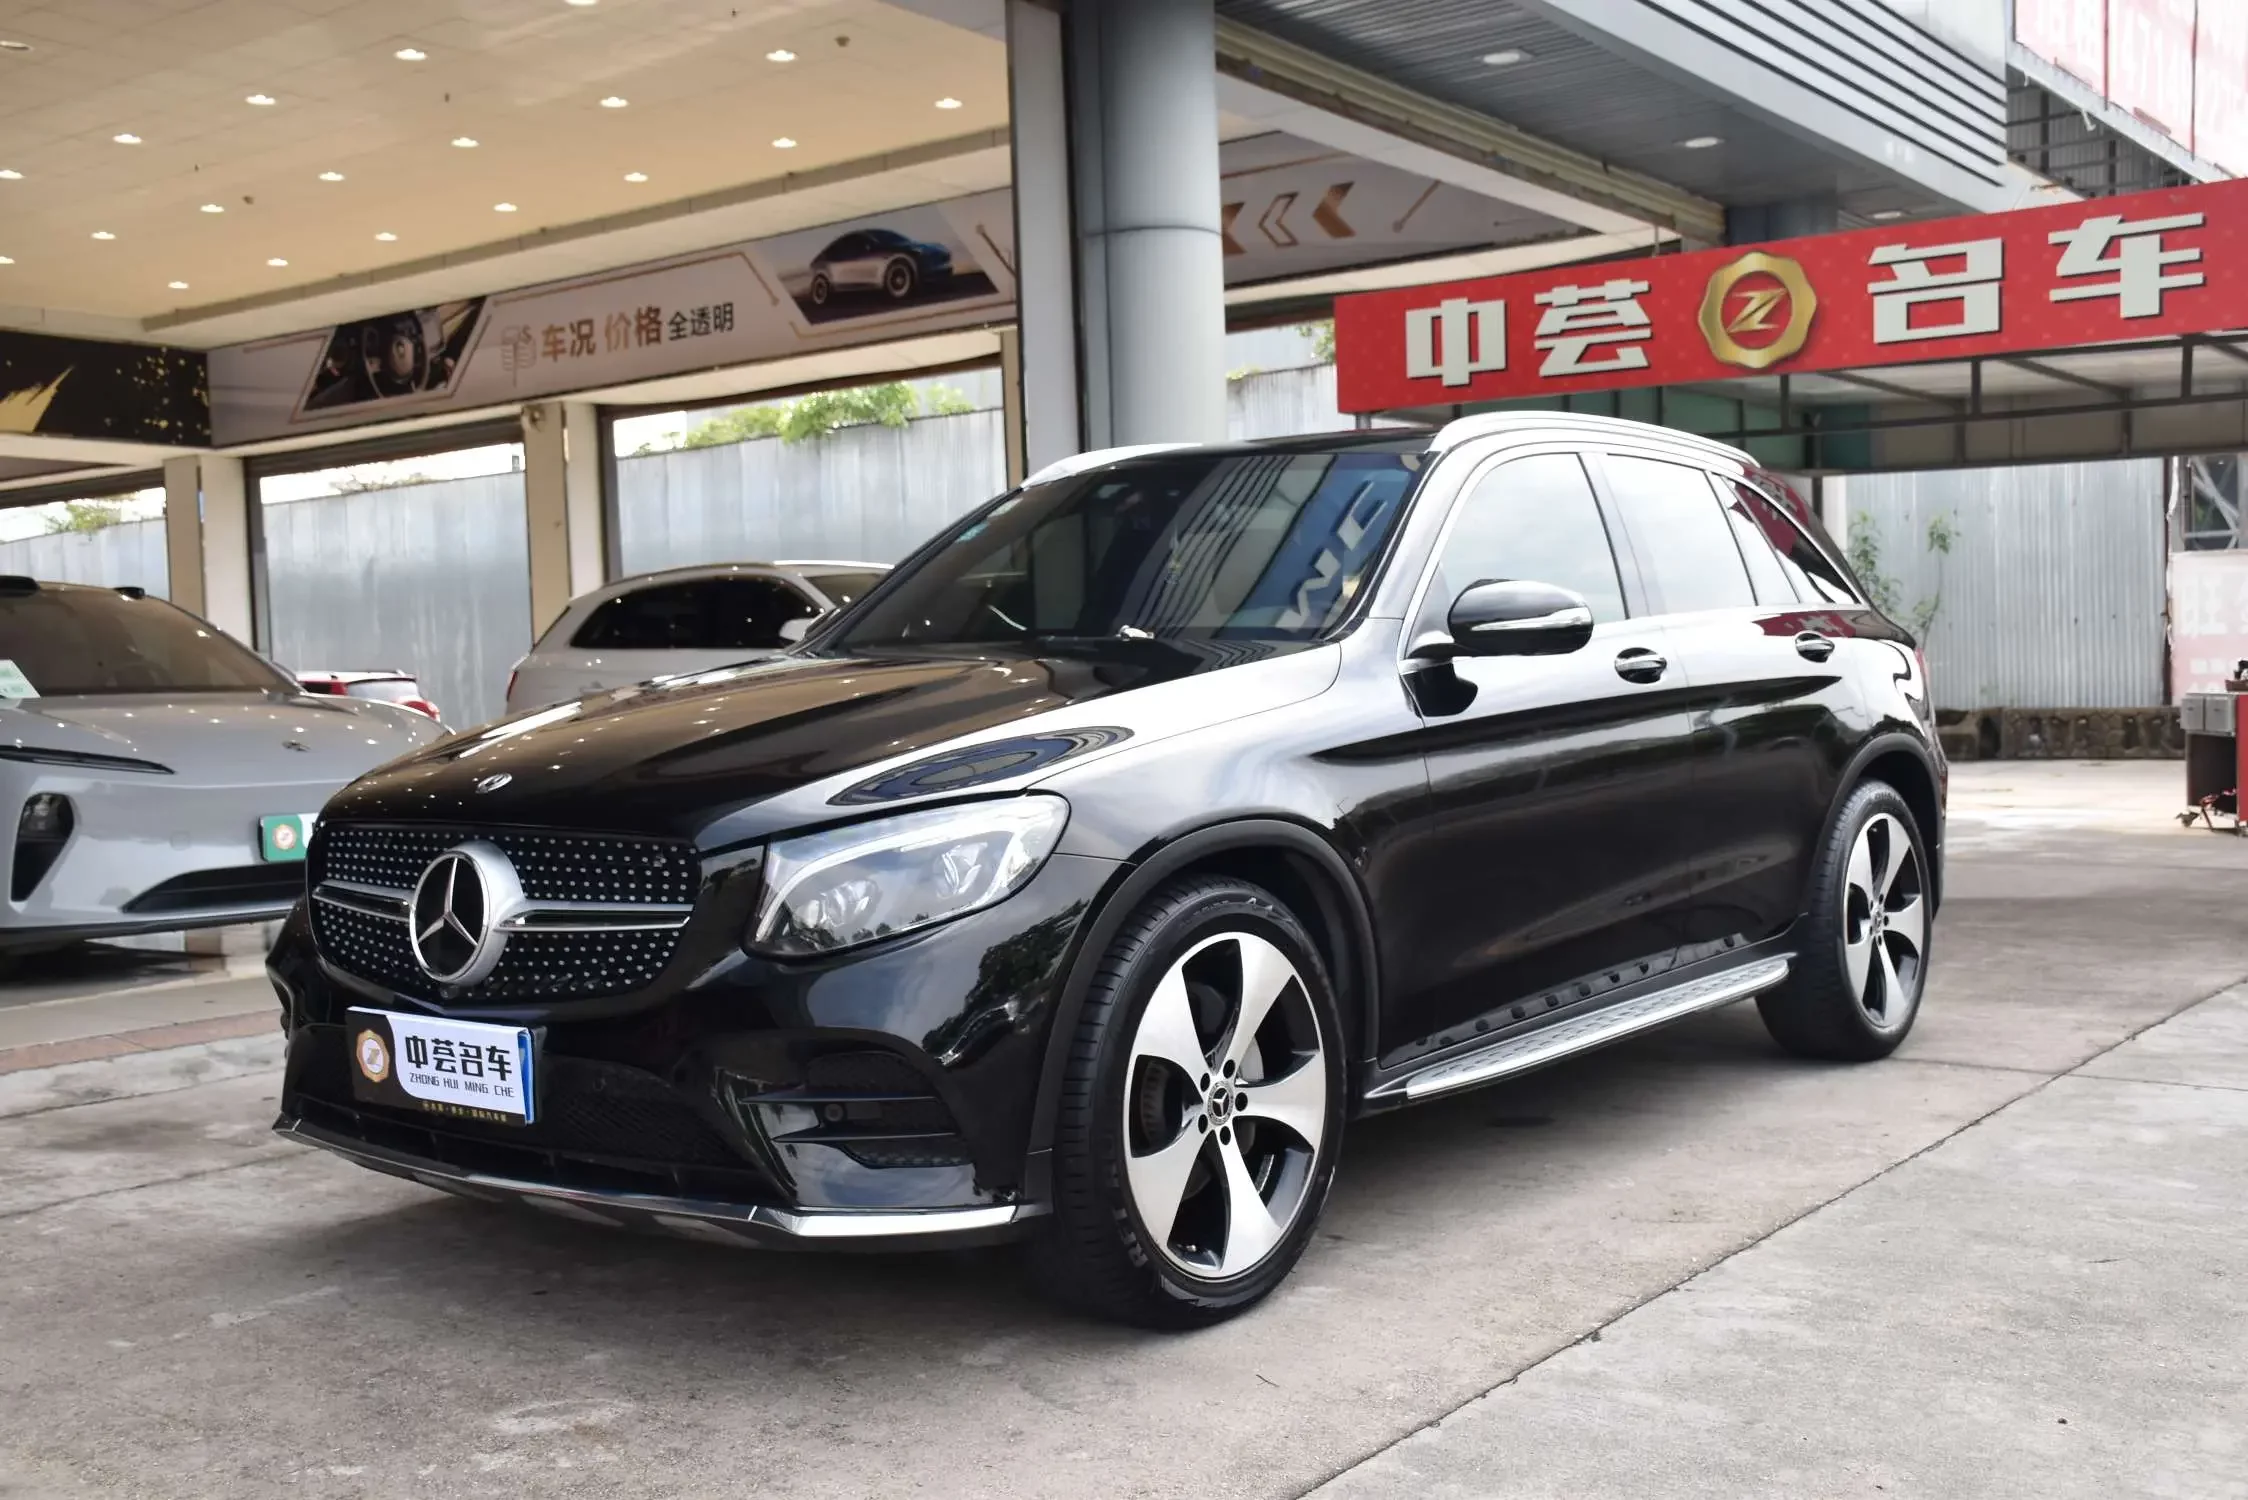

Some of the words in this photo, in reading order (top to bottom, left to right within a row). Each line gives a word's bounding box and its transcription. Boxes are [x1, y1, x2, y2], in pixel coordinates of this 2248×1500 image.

[1867, 212, 2204, 344] 名车
[541, 318, 597, 363] 车况
[604, 305, 663, 353] 价格
[668, 301, 735, 342] 全透明
[1405, 278, 1652, 387] 中荟
[405, 1035, 512, 1081] 中荟名车
[409, 1072, 440, 1087] ZHONG
[443, 1075, 460, 1090] HUI
[464, 1080, 489, 1094] MING
[494, 1085, 516, 1098] CHE
